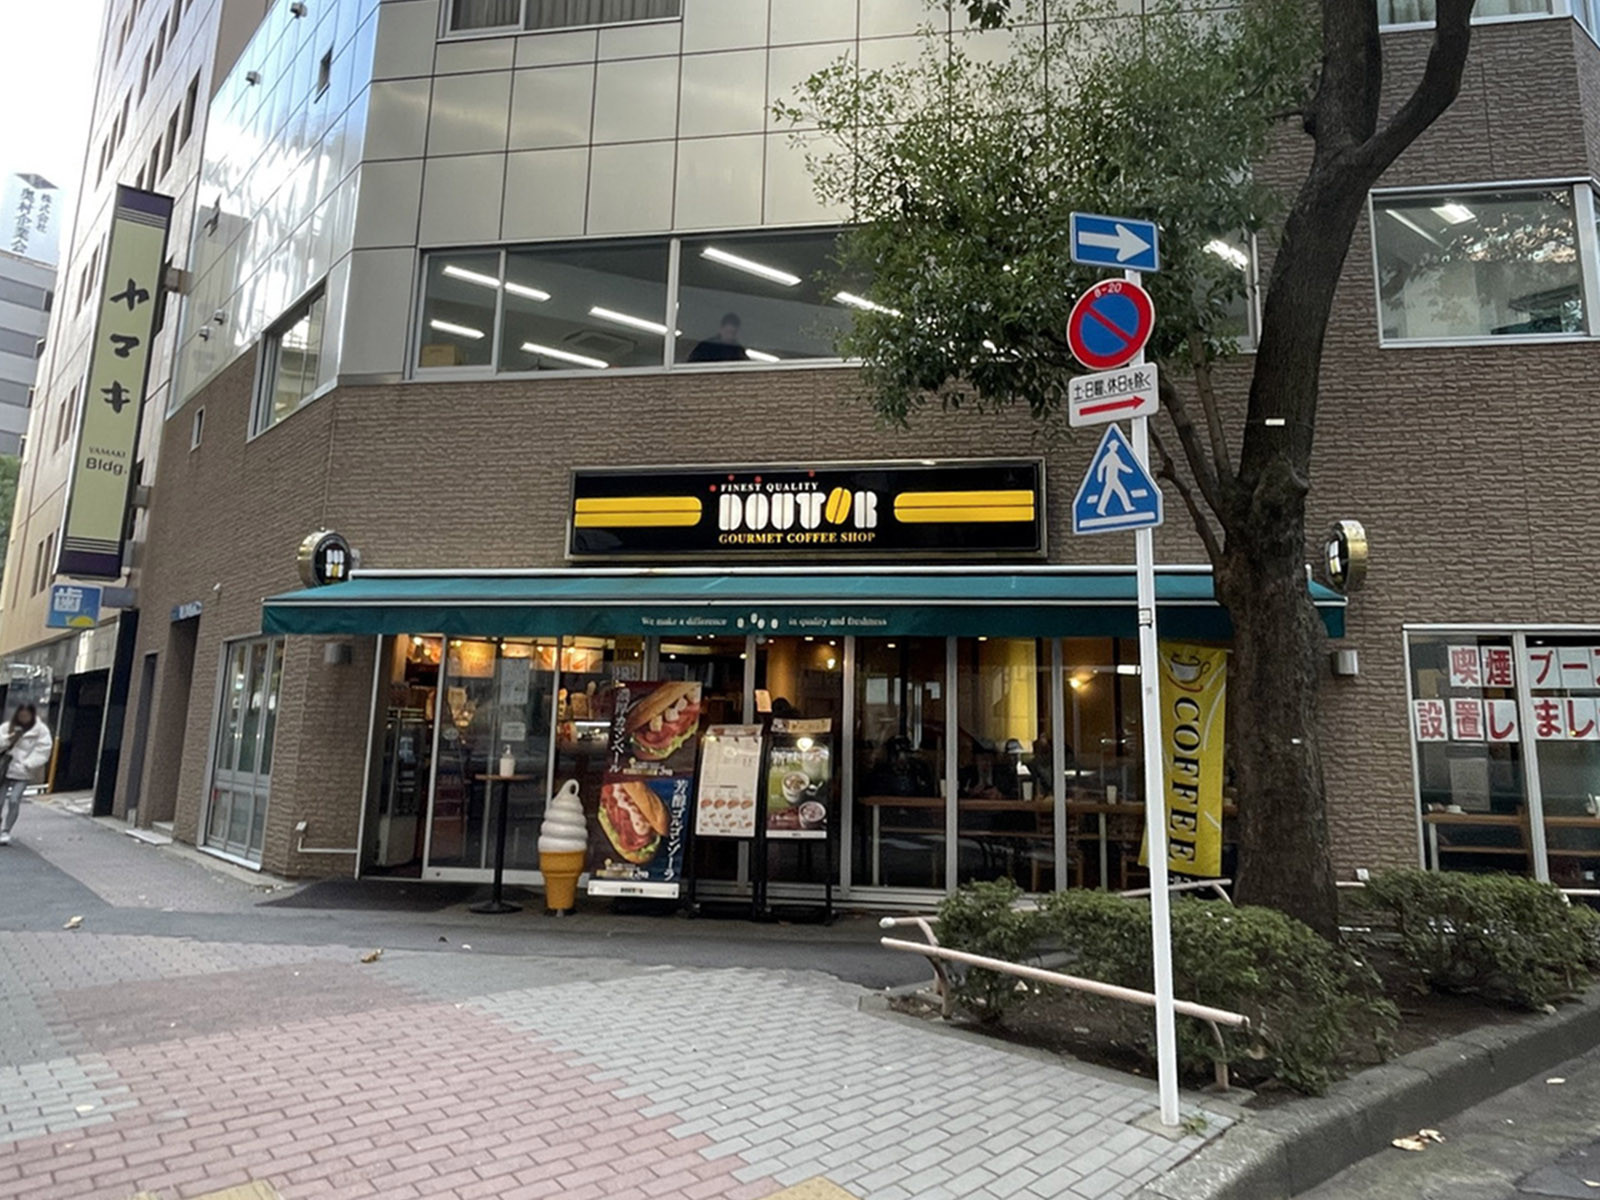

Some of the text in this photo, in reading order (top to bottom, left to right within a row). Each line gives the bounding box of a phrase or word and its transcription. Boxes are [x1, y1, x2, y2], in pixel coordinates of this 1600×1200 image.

[100, 278, 150, 415] ヤマキ
[88, 446, 127, 459] YAMAKI
[86, 457, 127, 476] Bldg.
[720, 482, 819, 492] FINEST QUALITY
[718, 487, 878, 531] DOUTOR
[718, 531, 876, 544] GOURMET COFFEE SHOP
[53, 587, 83, 613] 歯
[641, 617, 654, 626] We
[656, 616, 677, 626] make
[686, 616, 728, 626] difference
[788, 616, 888, 628] in quality and freshness
[1450, 647, 1600, 687] 喫煙ブー
[1417, 699, 1600, 739] 設置しまし
[1167, 696, 1201, 864] COFFEE
